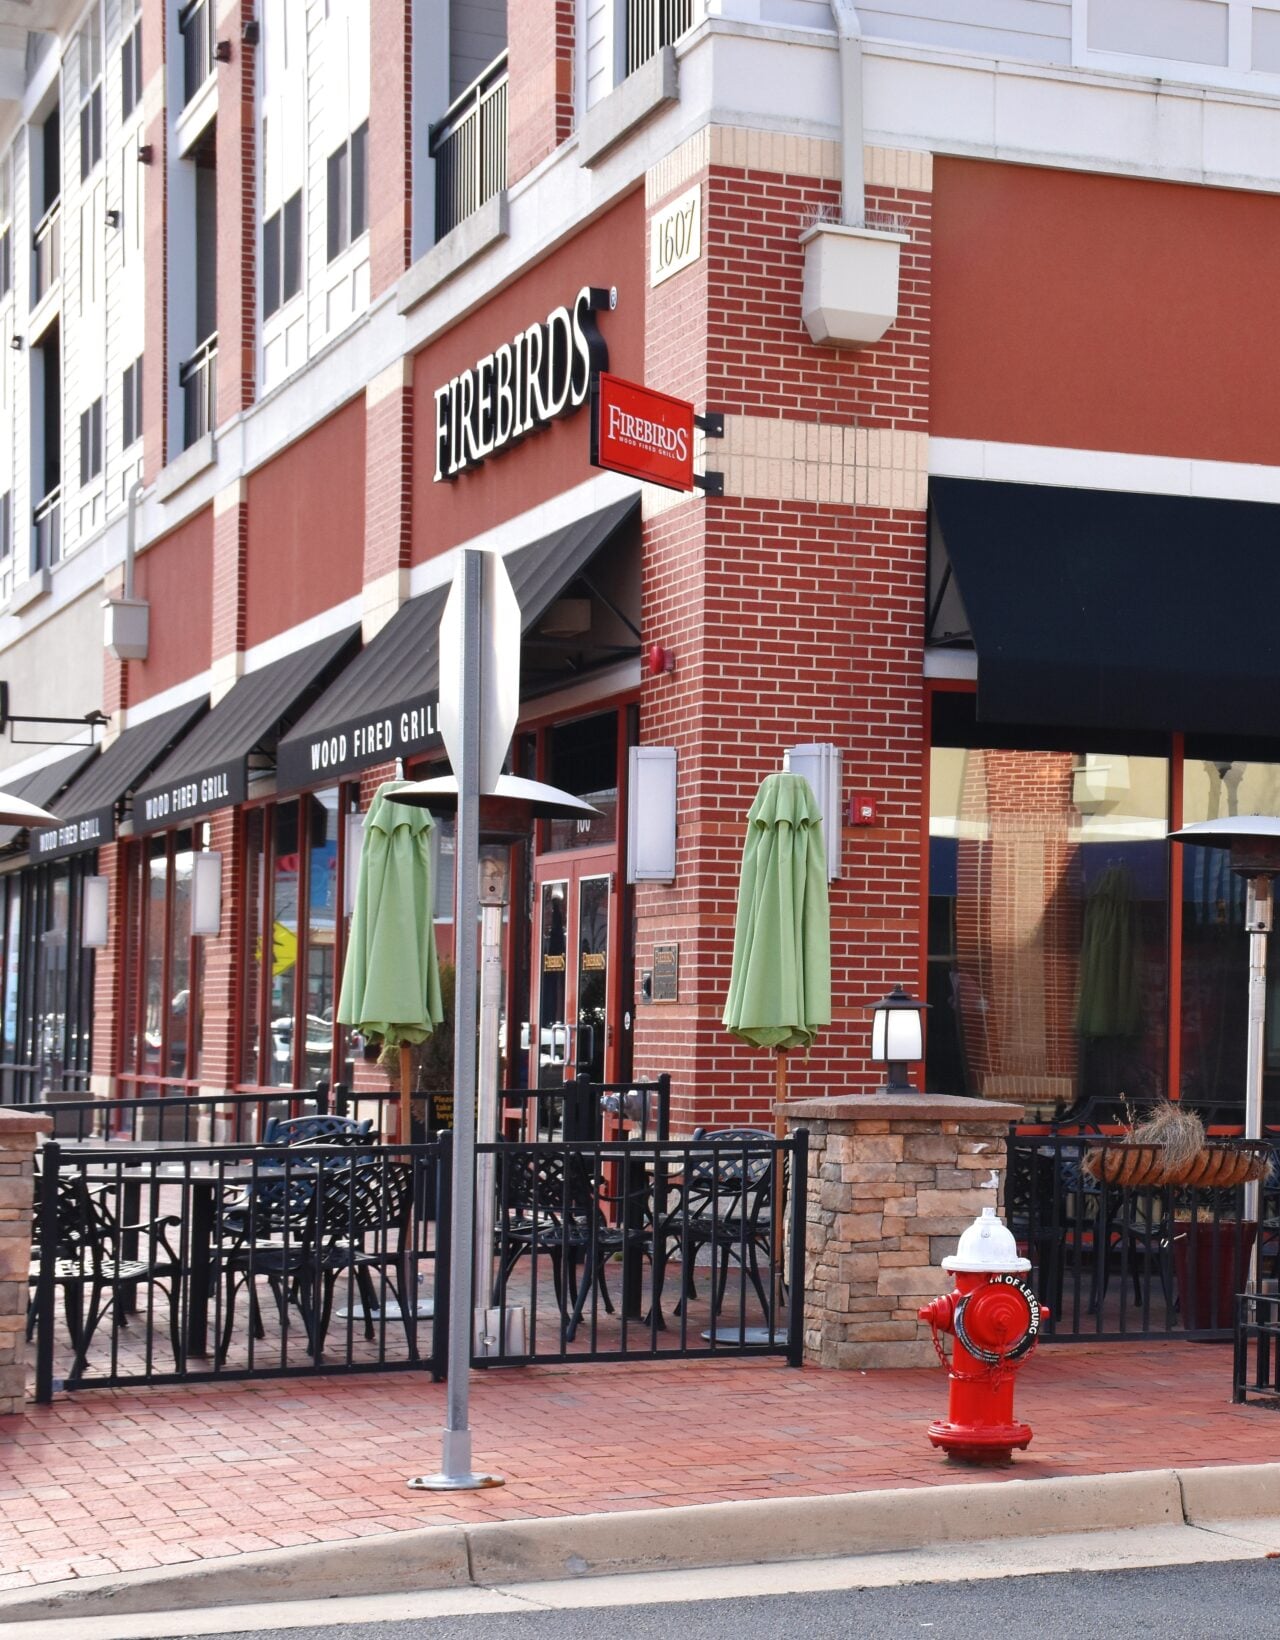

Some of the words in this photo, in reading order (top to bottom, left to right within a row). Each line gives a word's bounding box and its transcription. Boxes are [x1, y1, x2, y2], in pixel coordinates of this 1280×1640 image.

[655, 199, 696, 273] 1607
[433, 286, 592, 482] FIREBIRDS
[607, 403, 688, 462] FIREBIRDS
[619, 436, 637, 446] WOOD
[638, 442, 657, 453] FIRED
[658, 449, 676, 459] GRILL
[311, 733, 347, 770] WOOD
[354, 720, 392, 757] FIRED
[146, 793, 170, 820] WOOD
[172, 783, 198, 812] FIRED
[201, 773, 228, 803] GRILL
[1005, 1275, 1020, 1287] OF
[1019, 1283, 1040, 1335] LEESBURG
